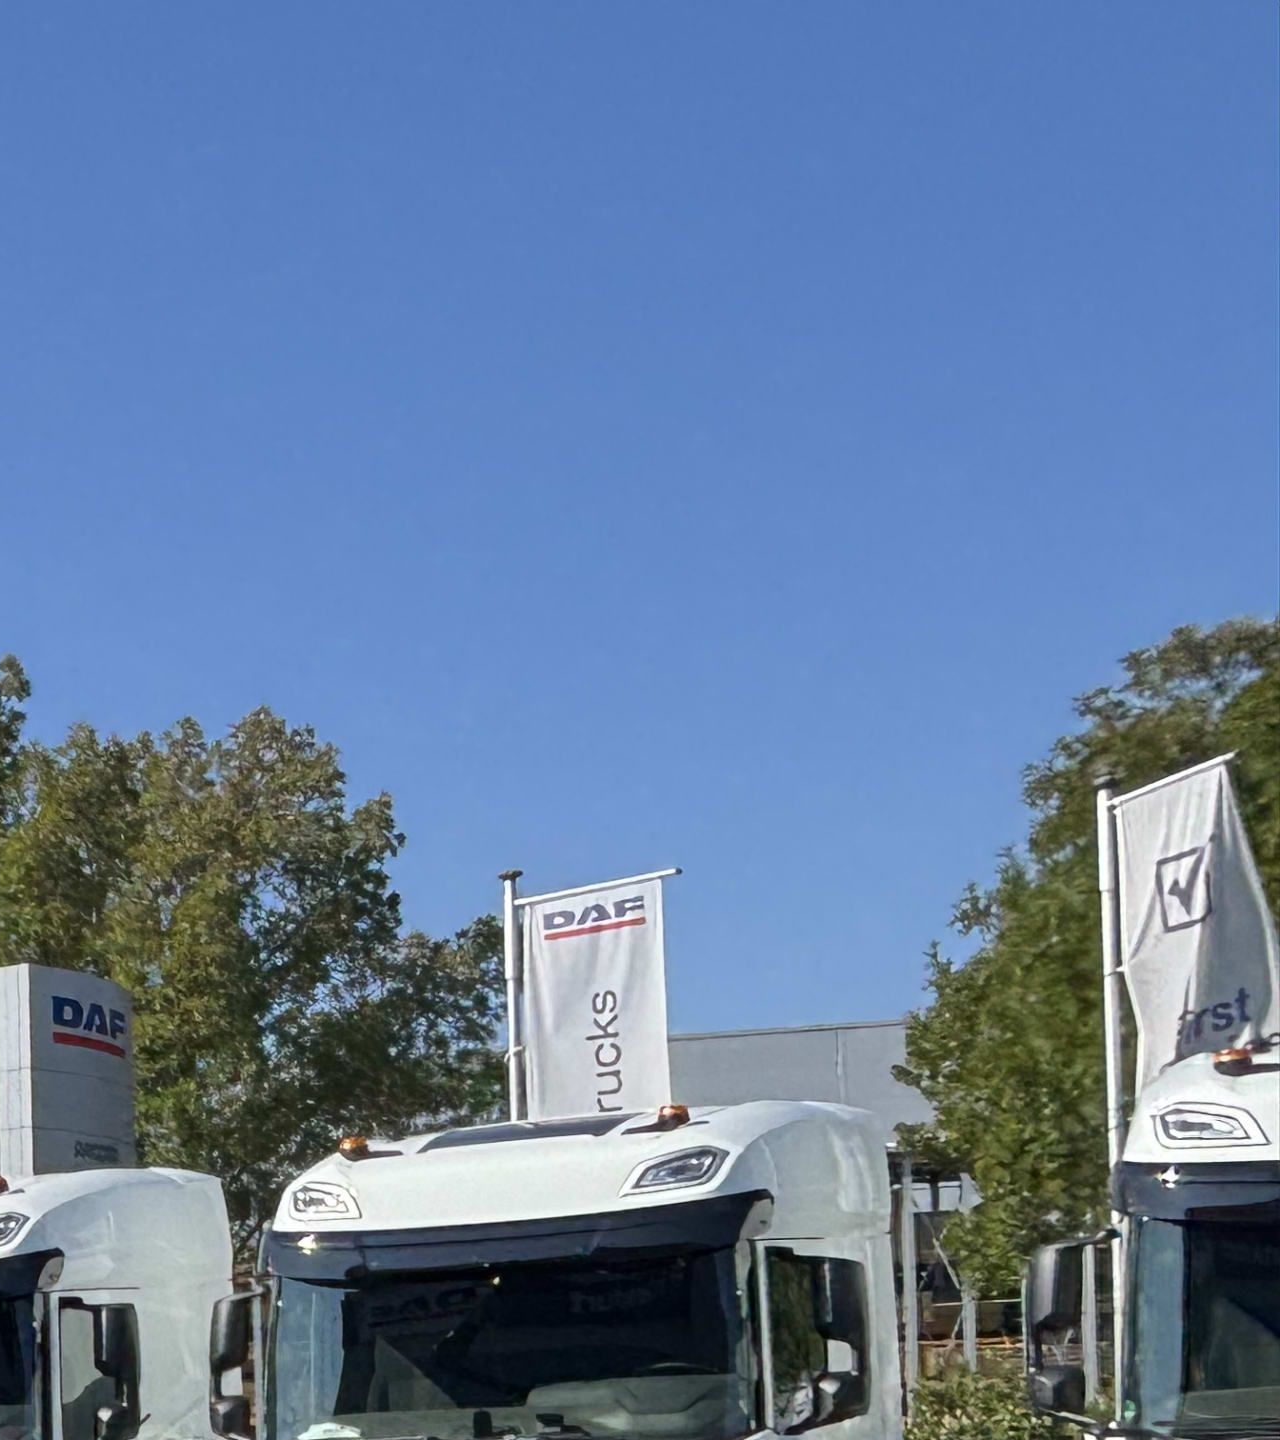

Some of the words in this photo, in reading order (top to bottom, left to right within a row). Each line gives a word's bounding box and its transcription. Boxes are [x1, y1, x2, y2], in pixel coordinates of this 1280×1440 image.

[543, 896, 645, 930] DAF
[52, 996, 126, 1040] DAF
[585, 990, 623, 1113] rucks
